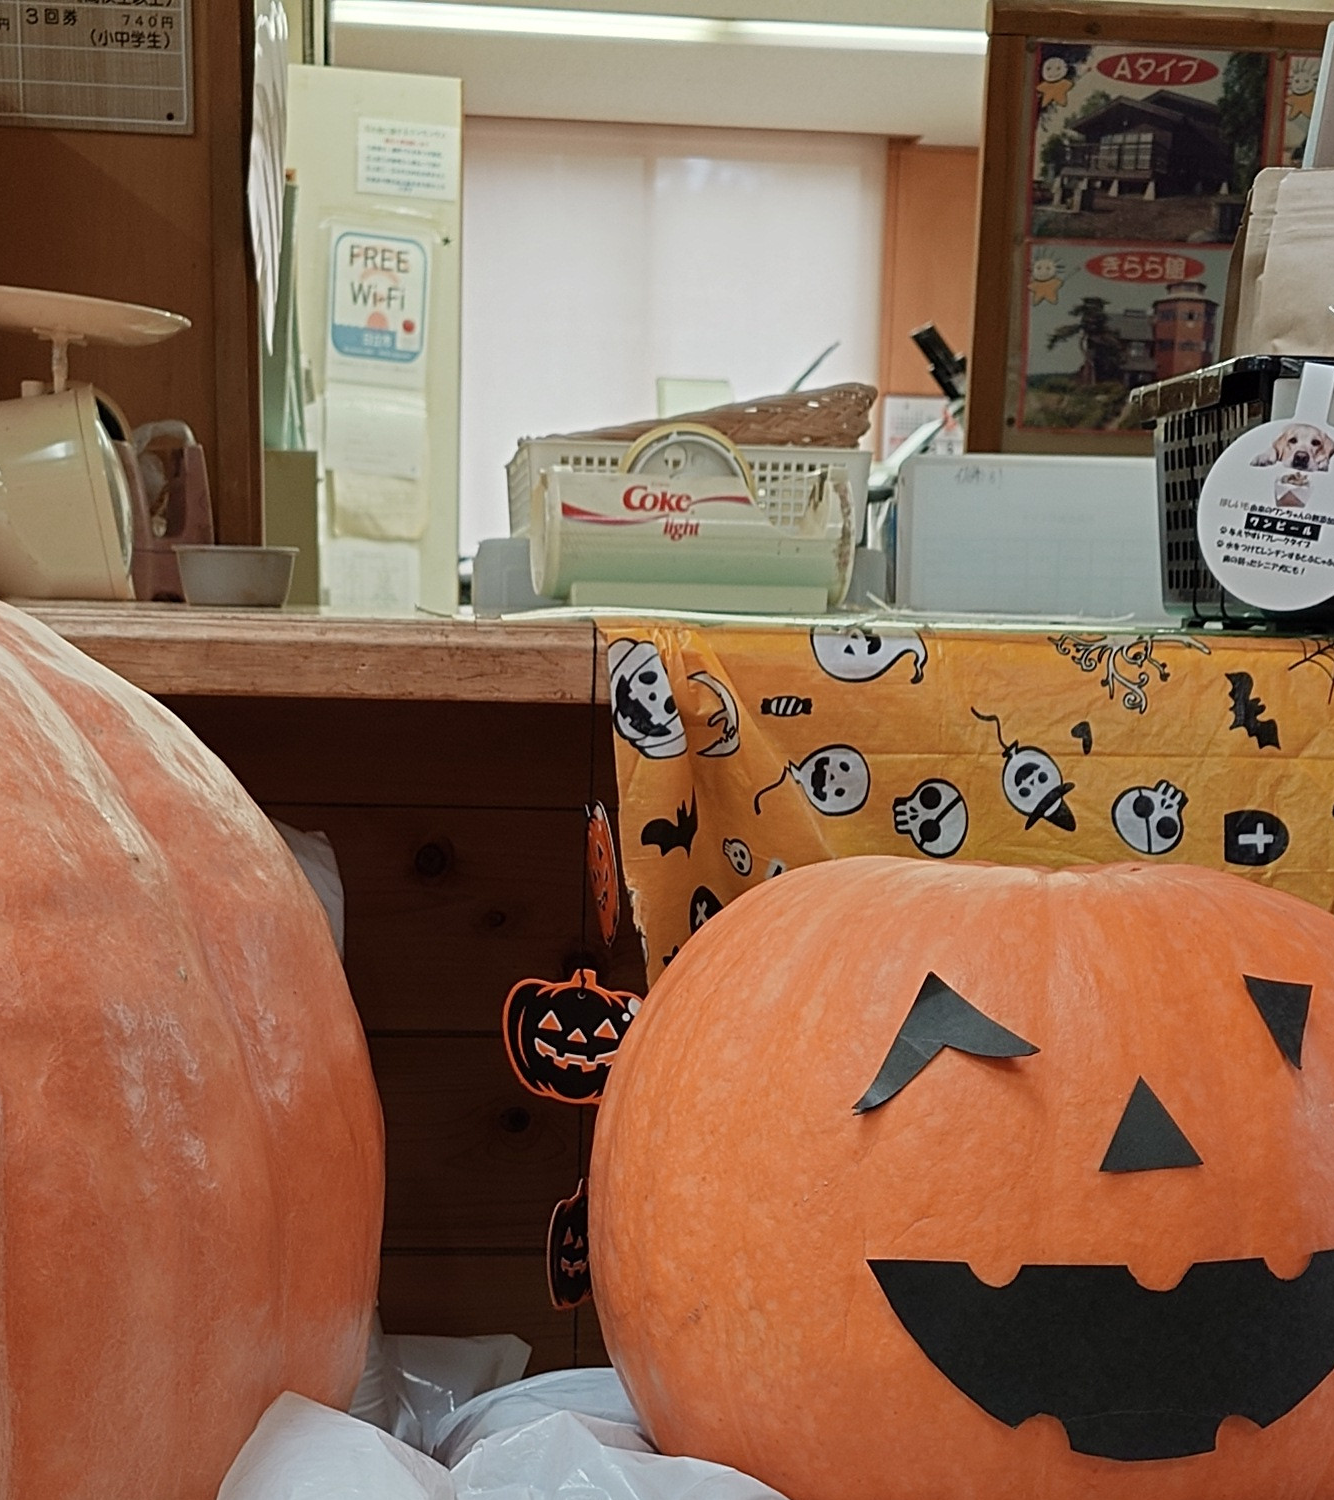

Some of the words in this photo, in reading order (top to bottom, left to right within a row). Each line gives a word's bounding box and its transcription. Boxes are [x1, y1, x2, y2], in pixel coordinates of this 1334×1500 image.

[25, 8, 78, 27] 3回券
[121, 14, 174, 30] 740円
[1113, 56, 1201, 83] Aタイプ
[349, 244, 410, 274] FREE
[351, 282, 406, 310] Wi-Fi
[622, 485, 692, 512] Coke
[663, 518, 700, 541] light
